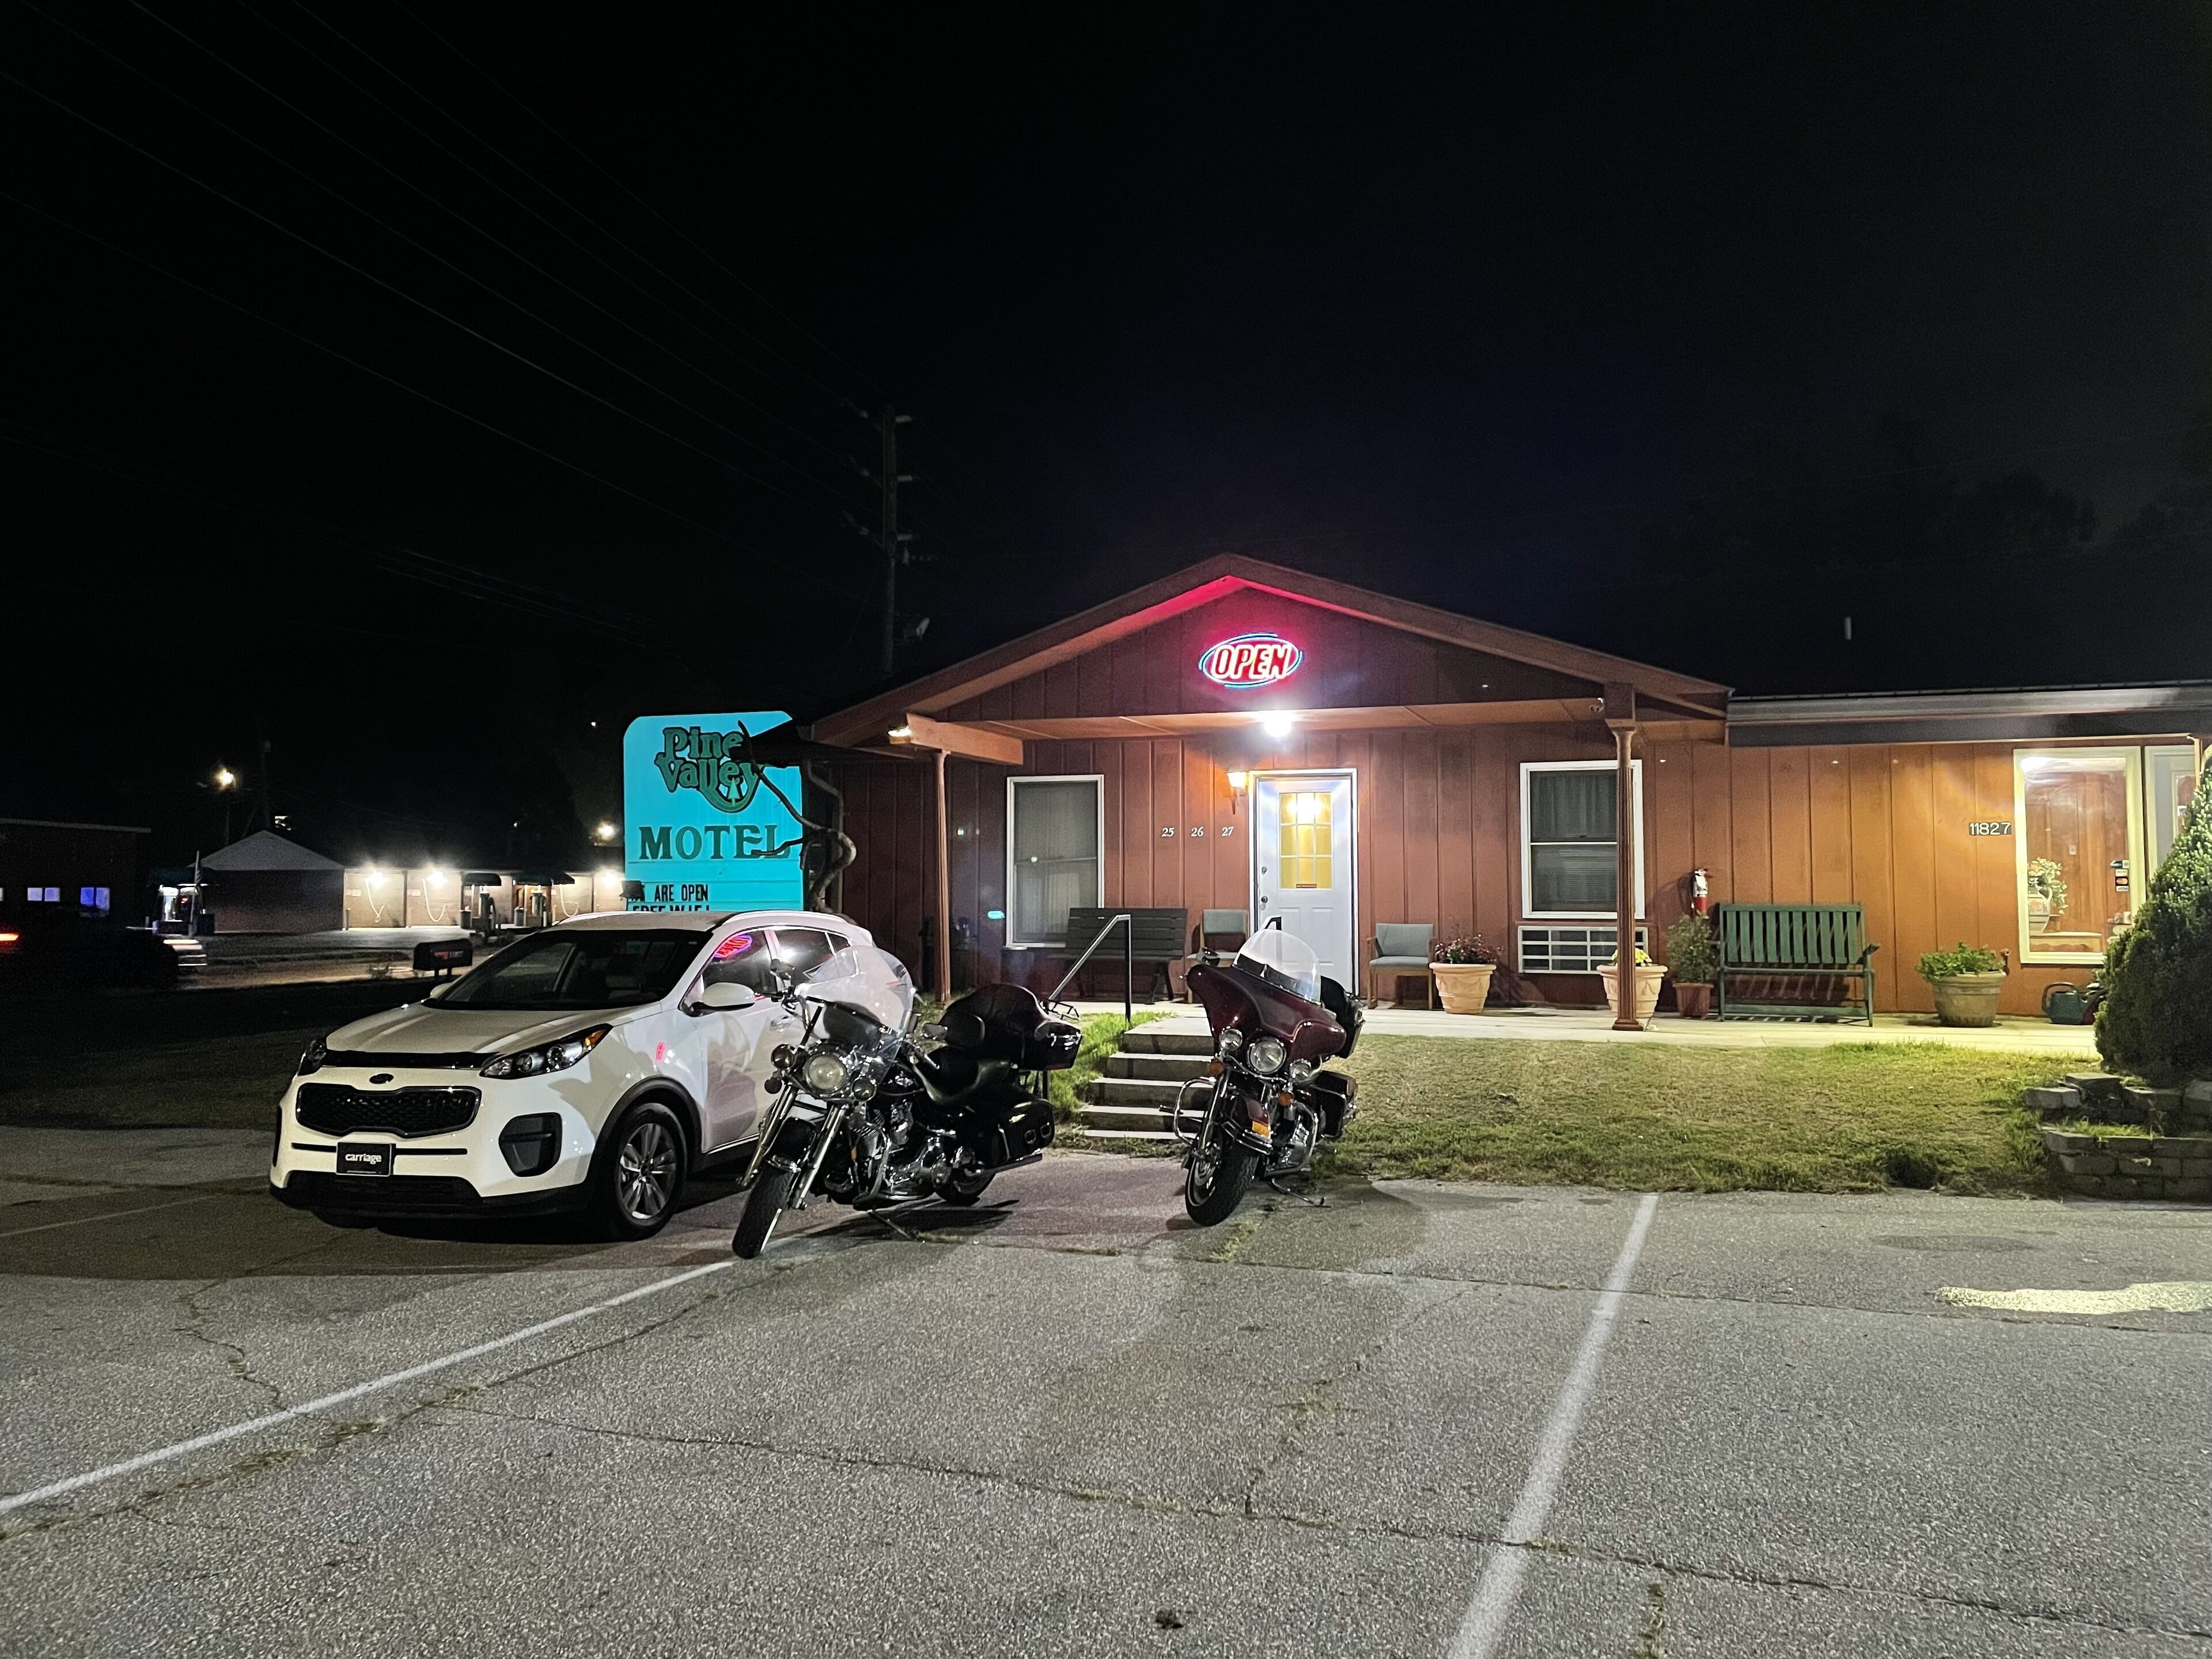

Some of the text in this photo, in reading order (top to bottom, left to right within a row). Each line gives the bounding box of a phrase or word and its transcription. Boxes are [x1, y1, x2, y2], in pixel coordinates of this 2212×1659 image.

[1211, 644, 1292, 679] OPEN
[662, 726, 745, 759] Pine
[654, 756, 764, 813] Valley
[1161, 826, 1234, 837] 25 26 27
[1969, 822, 2011, 835] 11827
[639, 825, 790, 859] MOTEL
[654, 884, 674, 902] ARE
[681, 884, 709, 902] OPEN
[345, 1153, 382, 1164] carriage
